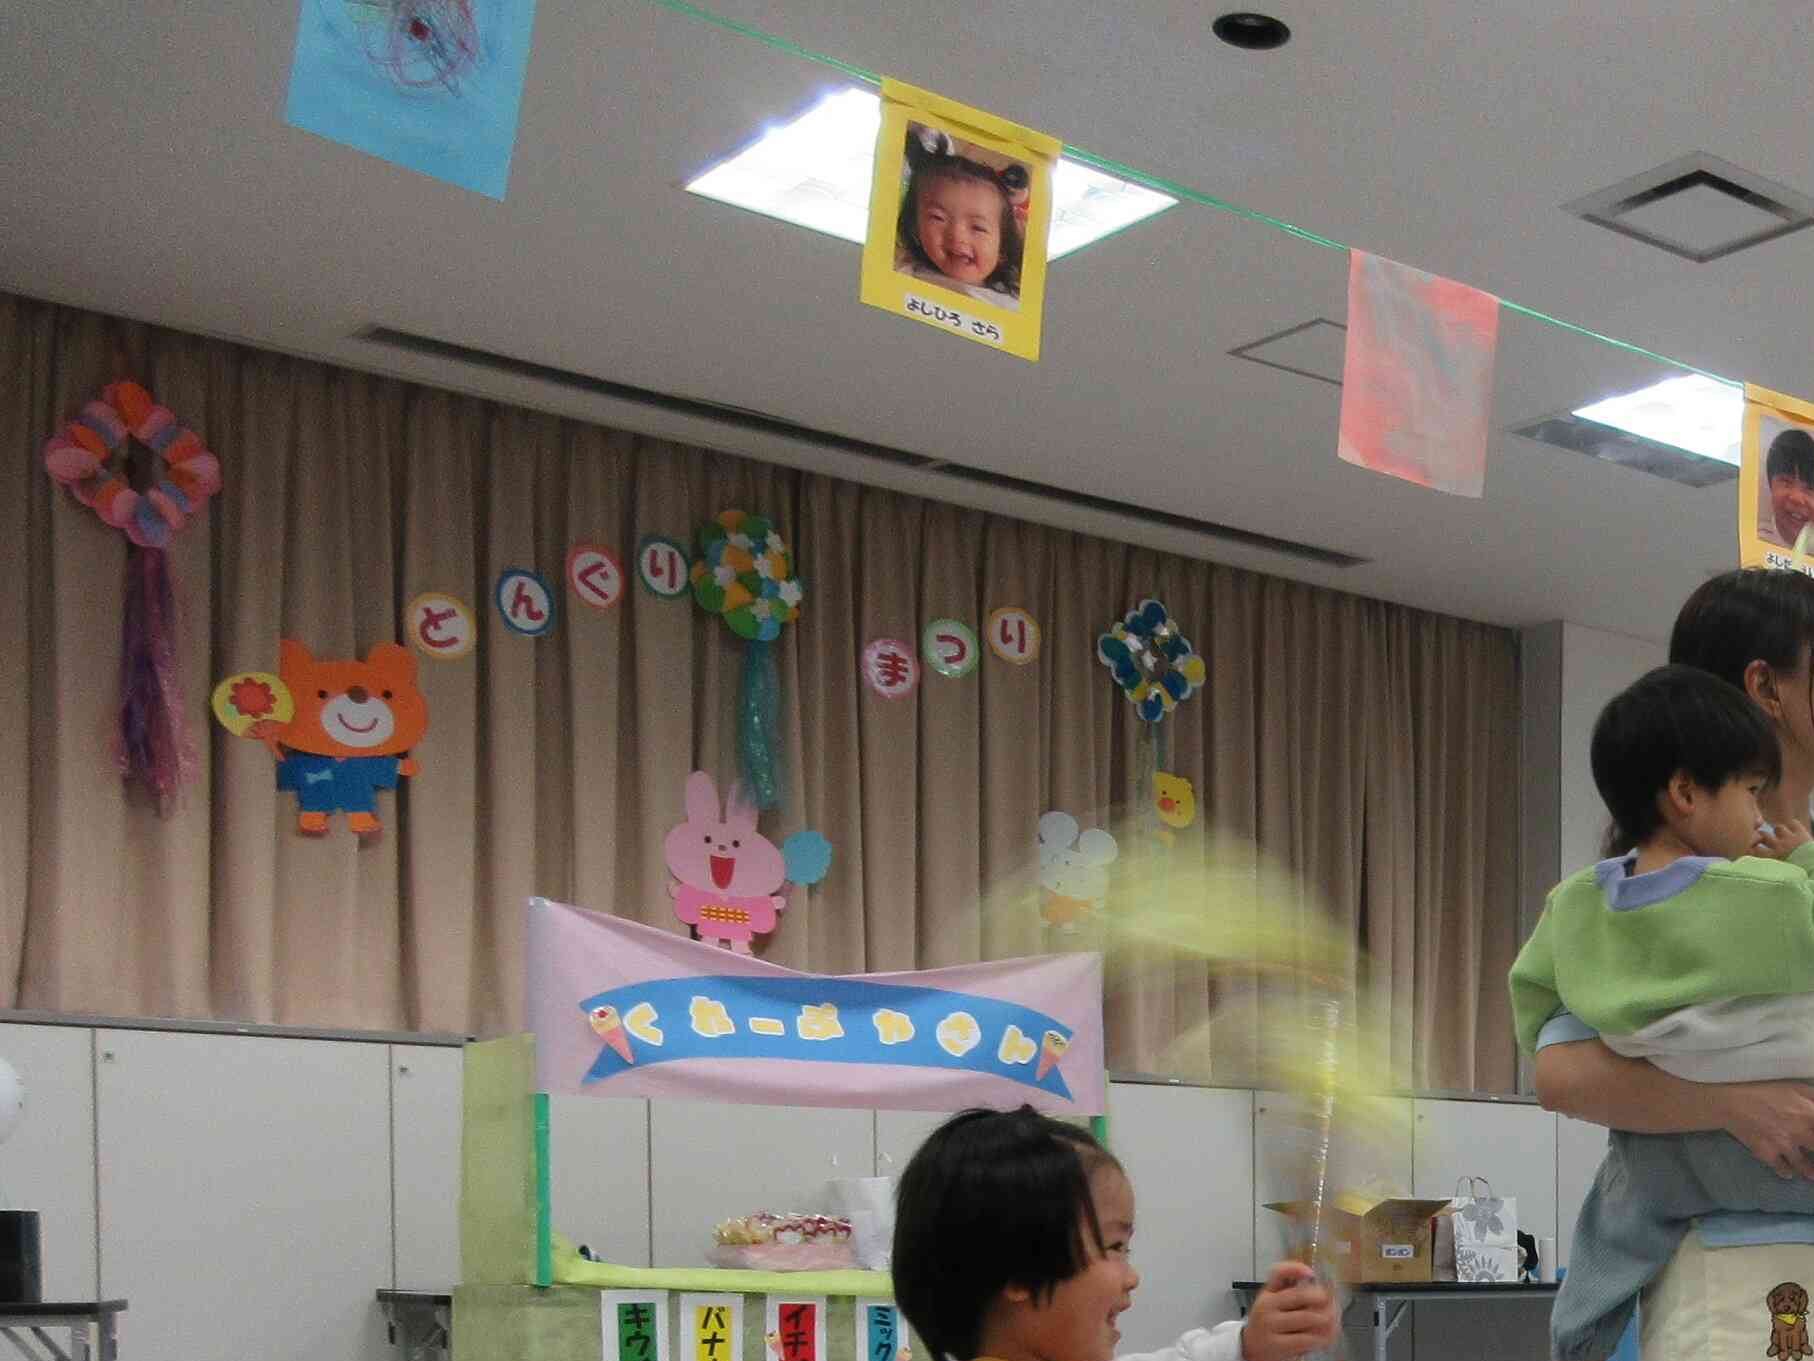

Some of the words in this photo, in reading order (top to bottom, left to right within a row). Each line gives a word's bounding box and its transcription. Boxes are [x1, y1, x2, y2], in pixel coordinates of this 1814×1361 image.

[906, 298, 961, 327] よしひろ
[623, 996, 1038, 1065] くれーぷやさん
